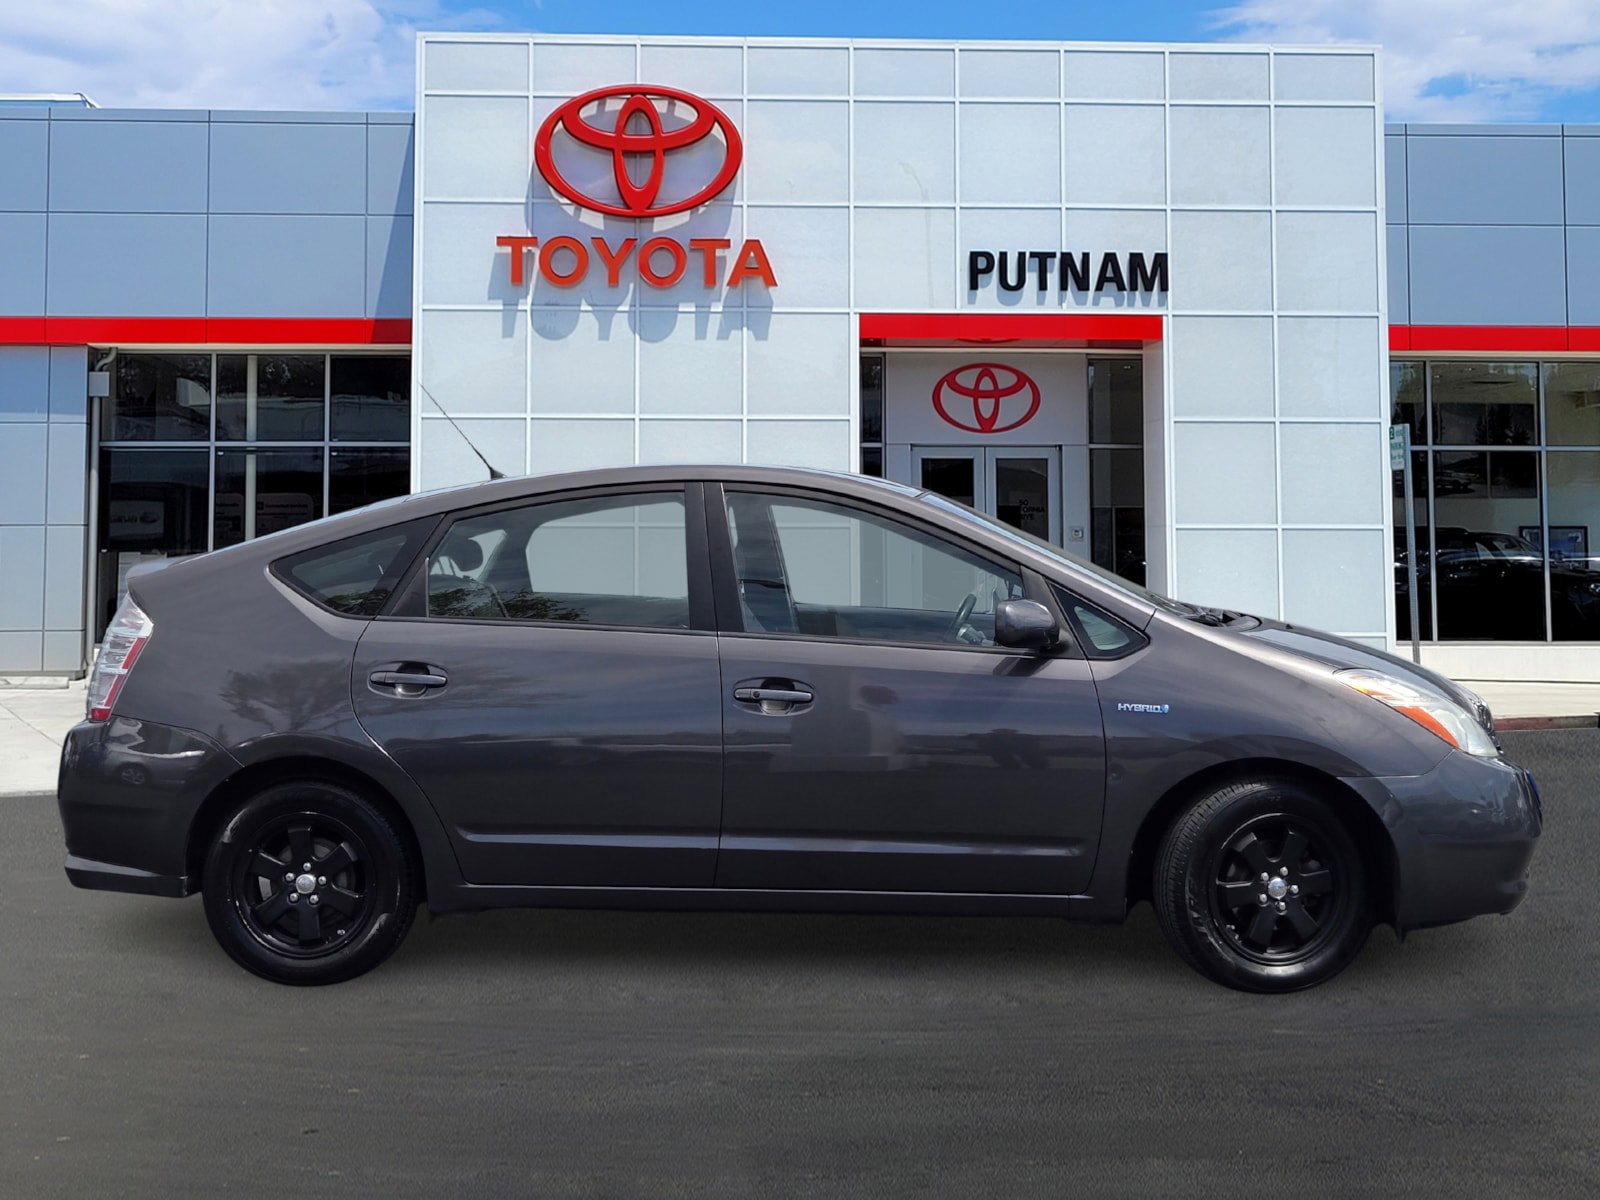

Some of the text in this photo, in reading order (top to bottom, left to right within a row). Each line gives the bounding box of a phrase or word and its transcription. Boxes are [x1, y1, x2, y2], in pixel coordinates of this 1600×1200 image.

[496, 236, 778, 288] TOYOTA
[969, 250, 1169, 292] PUTNAM
[1117, 702, 1161, 713] HYBRID
